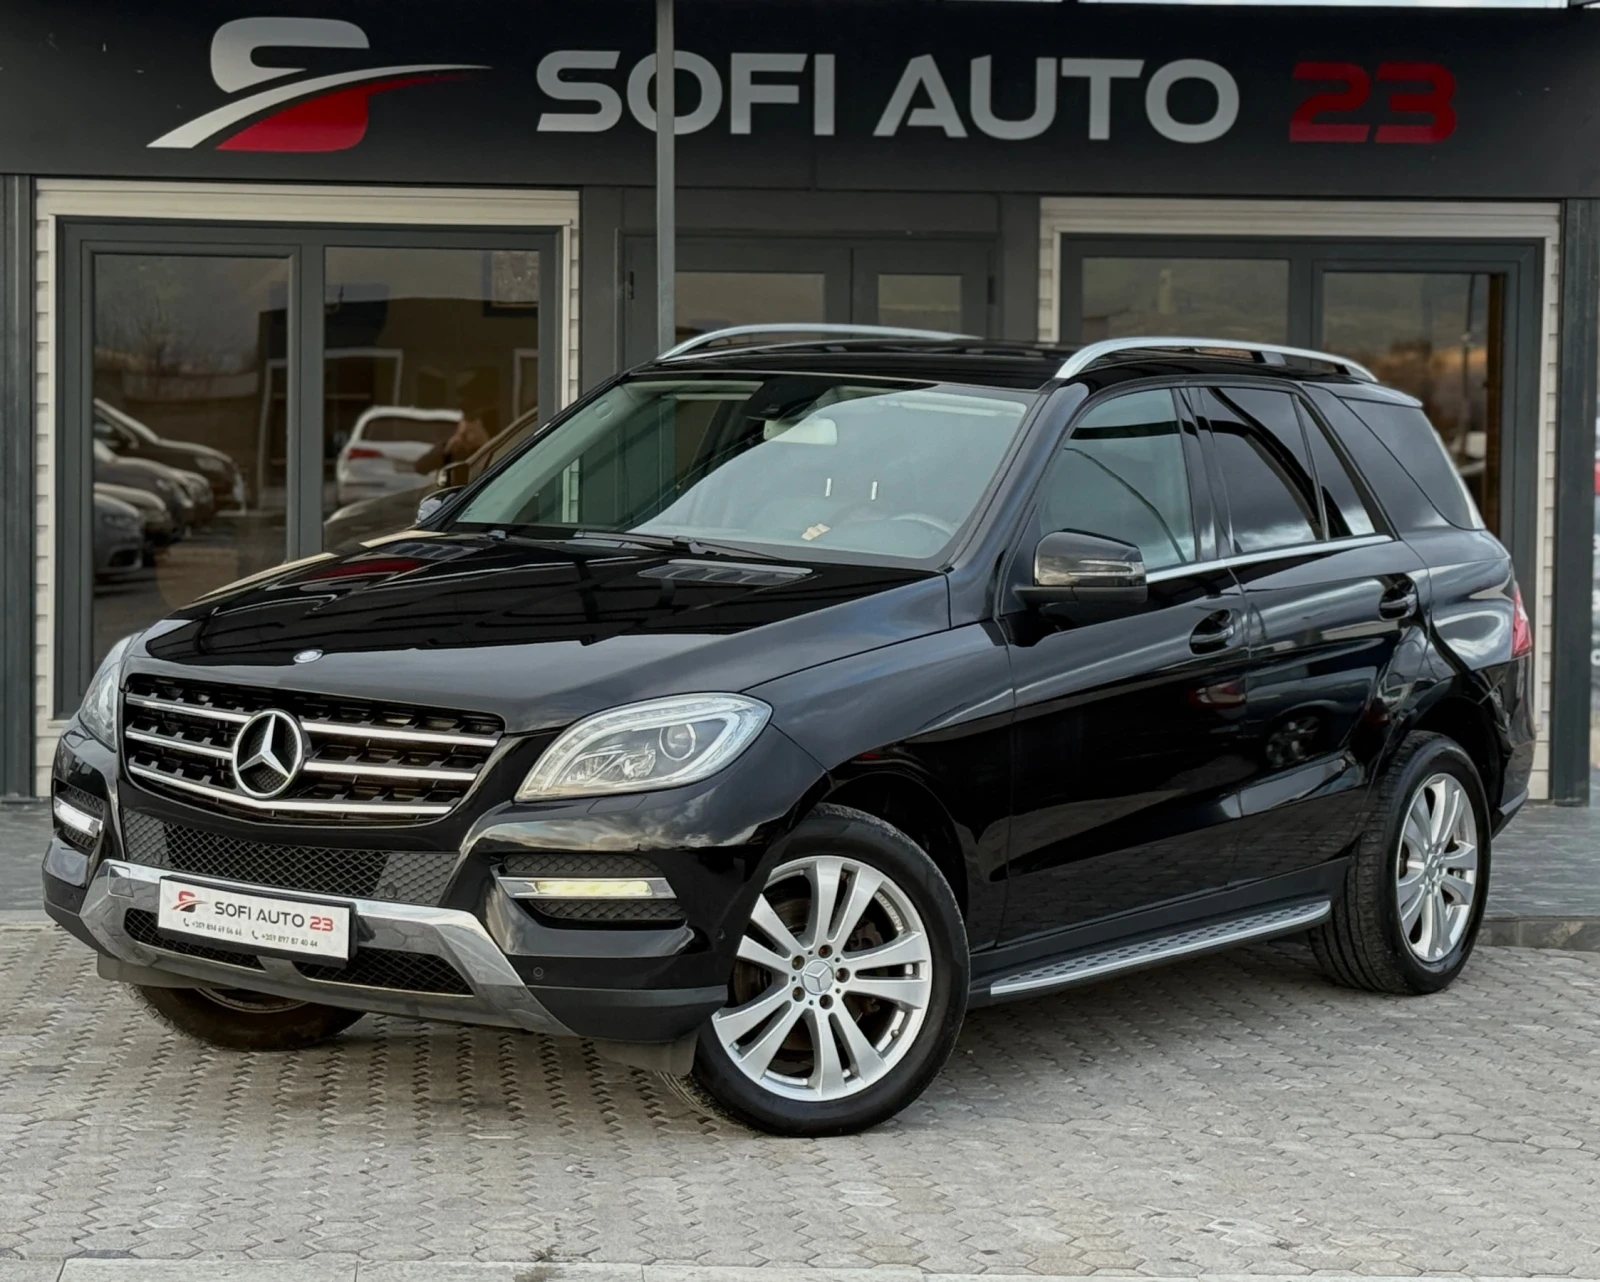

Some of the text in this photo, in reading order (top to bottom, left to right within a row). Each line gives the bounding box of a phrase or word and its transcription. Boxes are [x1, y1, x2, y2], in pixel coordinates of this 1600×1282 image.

[536, 50, 1457, 144] SOFI AUTO 23
[214, 901, 334, 932] SOFI AUTO 23
